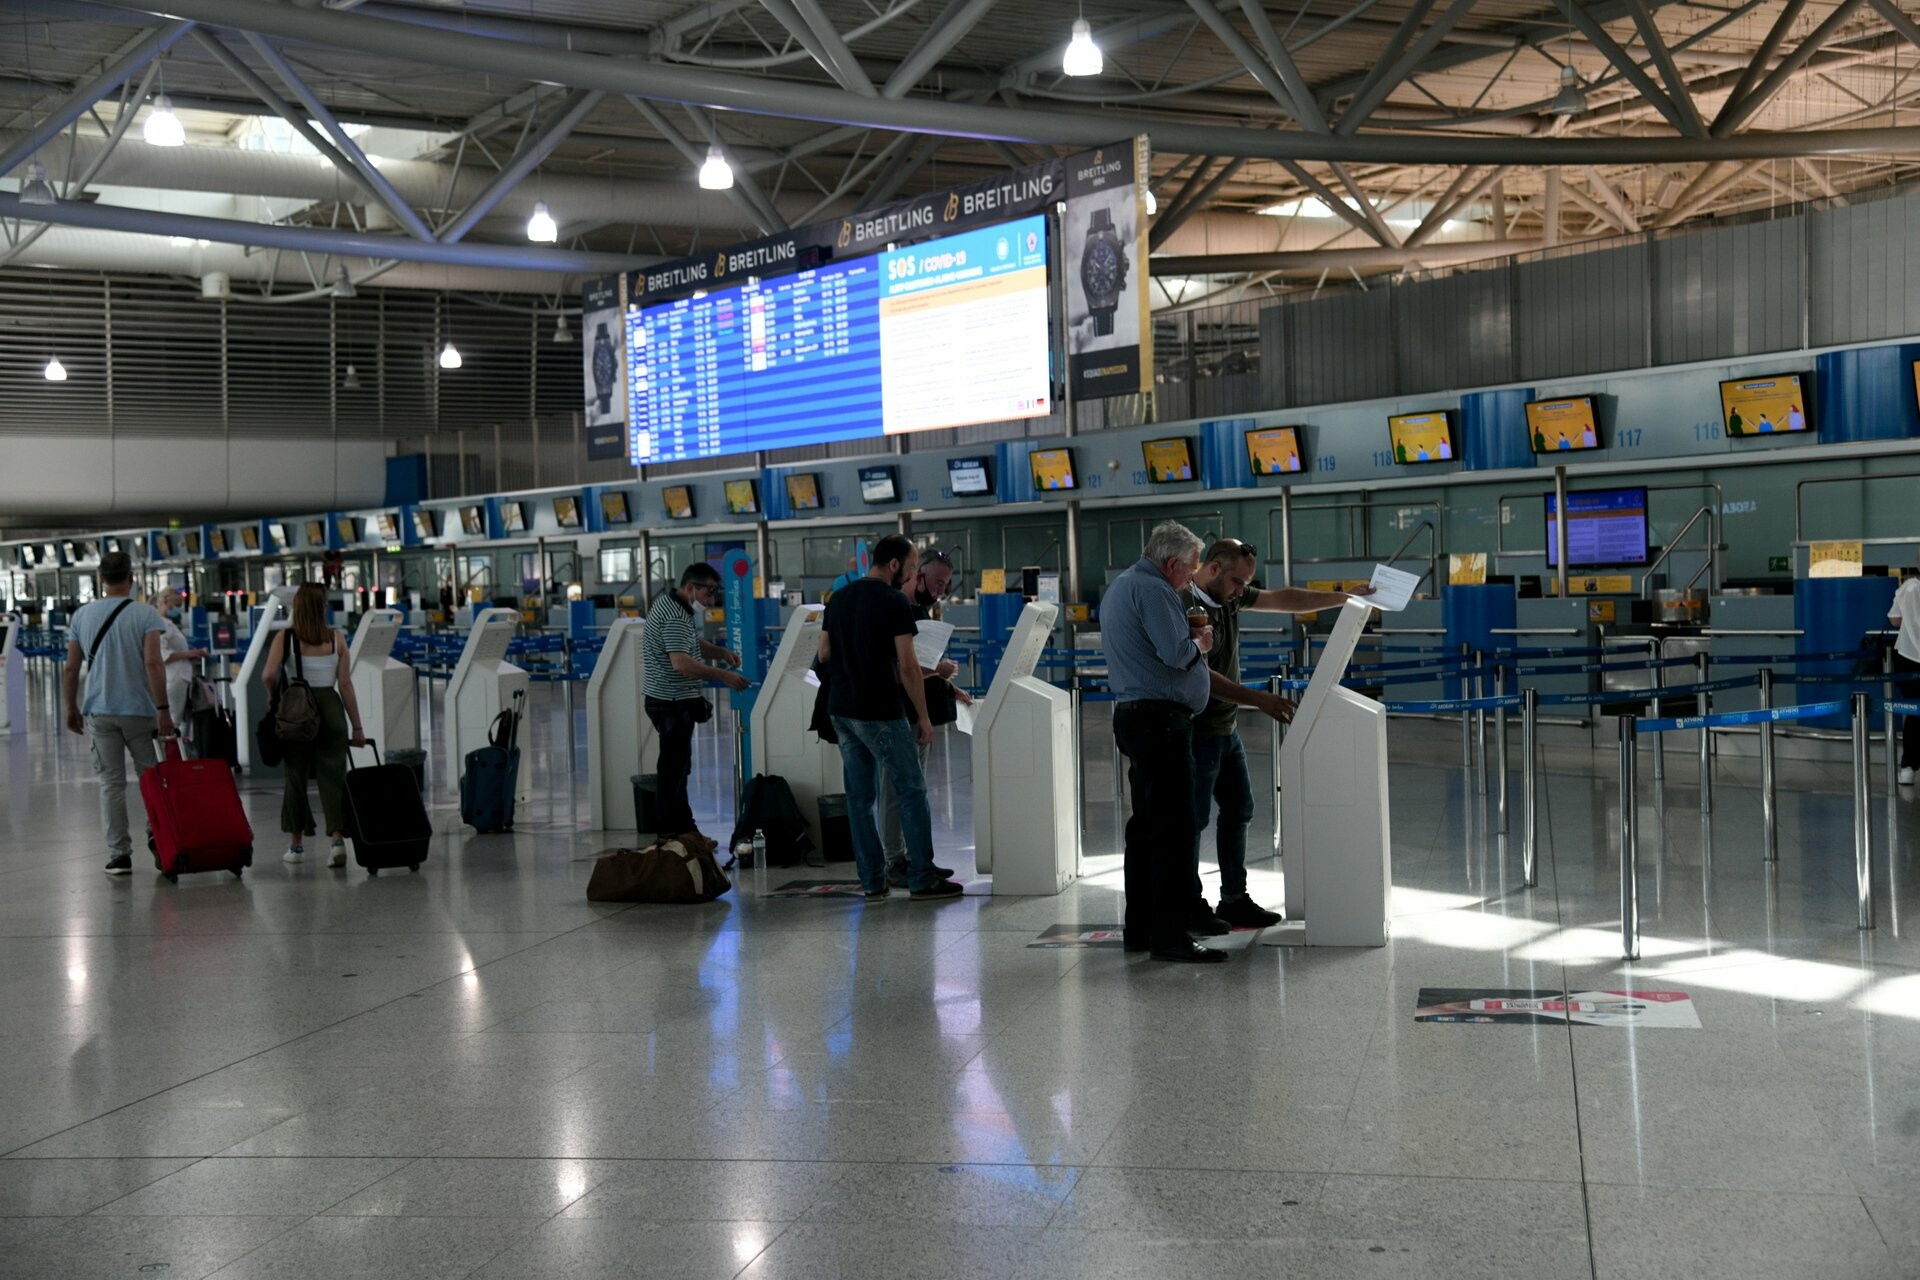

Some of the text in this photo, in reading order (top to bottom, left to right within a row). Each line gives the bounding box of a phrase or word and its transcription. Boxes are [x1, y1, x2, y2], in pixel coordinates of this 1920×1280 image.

[1078, 161, 1121, 181] BREITLING
[964, 175, 1053, 215] BREITLING
[855, 206, 934, 241] BREITLING
[729, 241, 796, 272] BREITLING
[888, 255, 916, 280] SOS
[924, 250, 967, 273] COVID-19
[648, 263, 708, 292] BREITLING
[1618, 428, 1642, 448] 117
[1693, 422, 1720, 441] 116
[1318, 456, 1336, 472] 119
[1373, 450, 1393, 467] 118
[1088, 474, 1102, 488] 121
[1132, 471, 1147, 485] 120
[730, 580, 741, 610] families
[732, 627, 743, 671] GEAN
[1893, 702, 1918, 710] ATHENS
